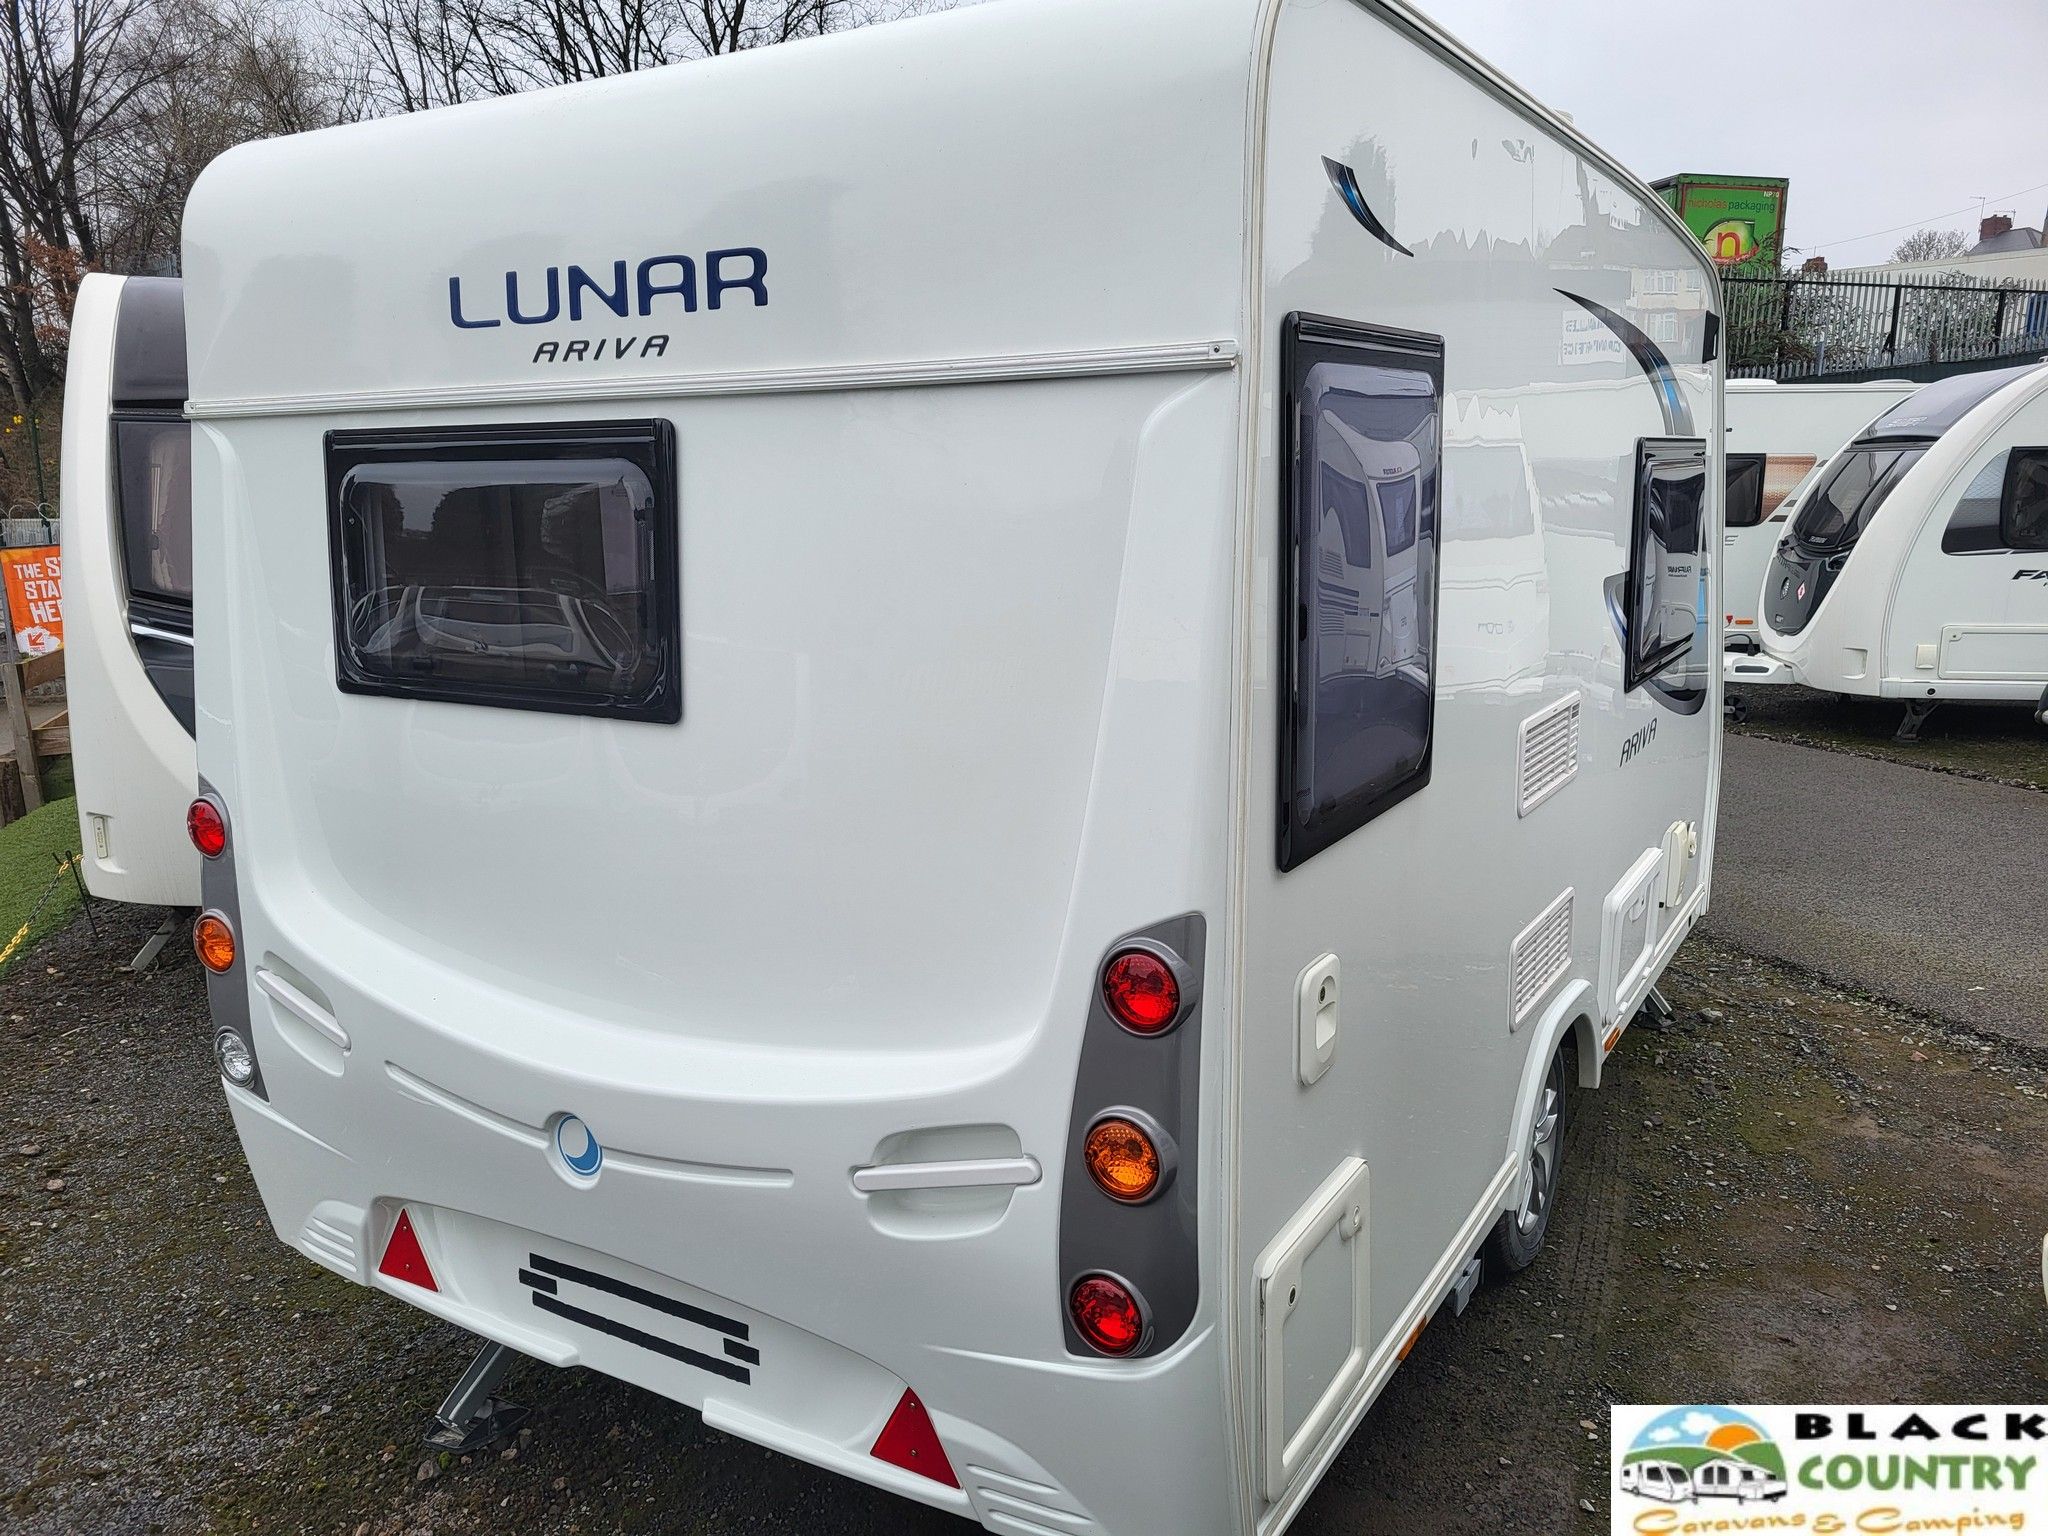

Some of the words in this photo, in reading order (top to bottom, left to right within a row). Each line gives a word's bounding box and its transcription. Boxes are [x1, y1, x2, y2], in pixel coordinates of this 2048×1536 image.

[1728, 200, 1776, 214] packaging
[449, 246, 768, 329] LUNAR
[532, 334, 670, 364] ARIVA
[13, 563, 44, 580] THE
[2011, 569, 2048, 580] FA
[24, 580, 63, 600] STA
[29, 600, 63, 624] HE
[1619, 717, 1658, 768] ARIVA
